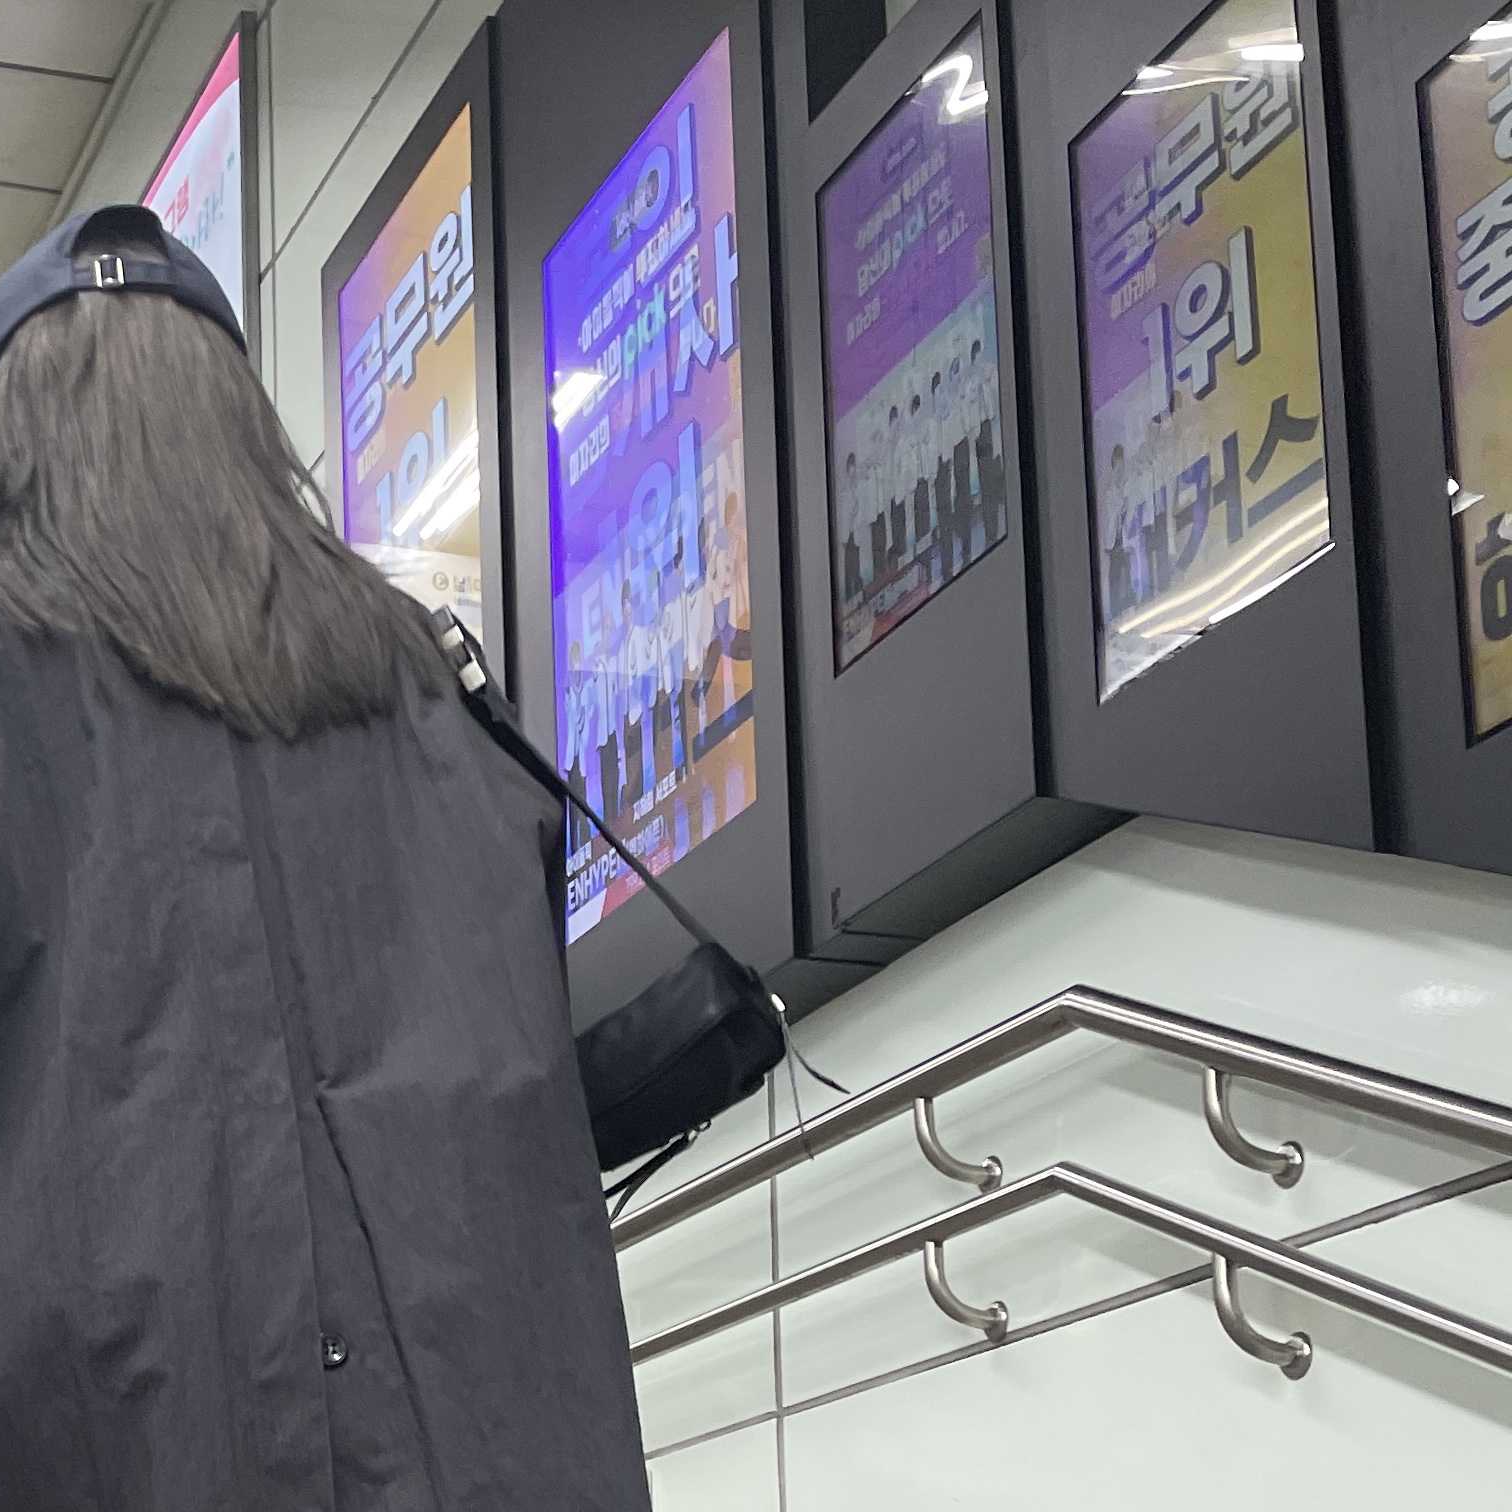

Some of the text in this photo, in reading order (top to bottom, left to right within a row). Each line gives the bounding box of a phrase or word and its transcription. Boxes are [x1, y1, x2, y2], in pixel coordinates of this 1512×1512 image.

[1090, 62, 1294, 293] 공무원
[344, 185, 475, 453] 공무원
[624, 282, 667, 381] pick
[1142, 226, 1255, 418] 1위
